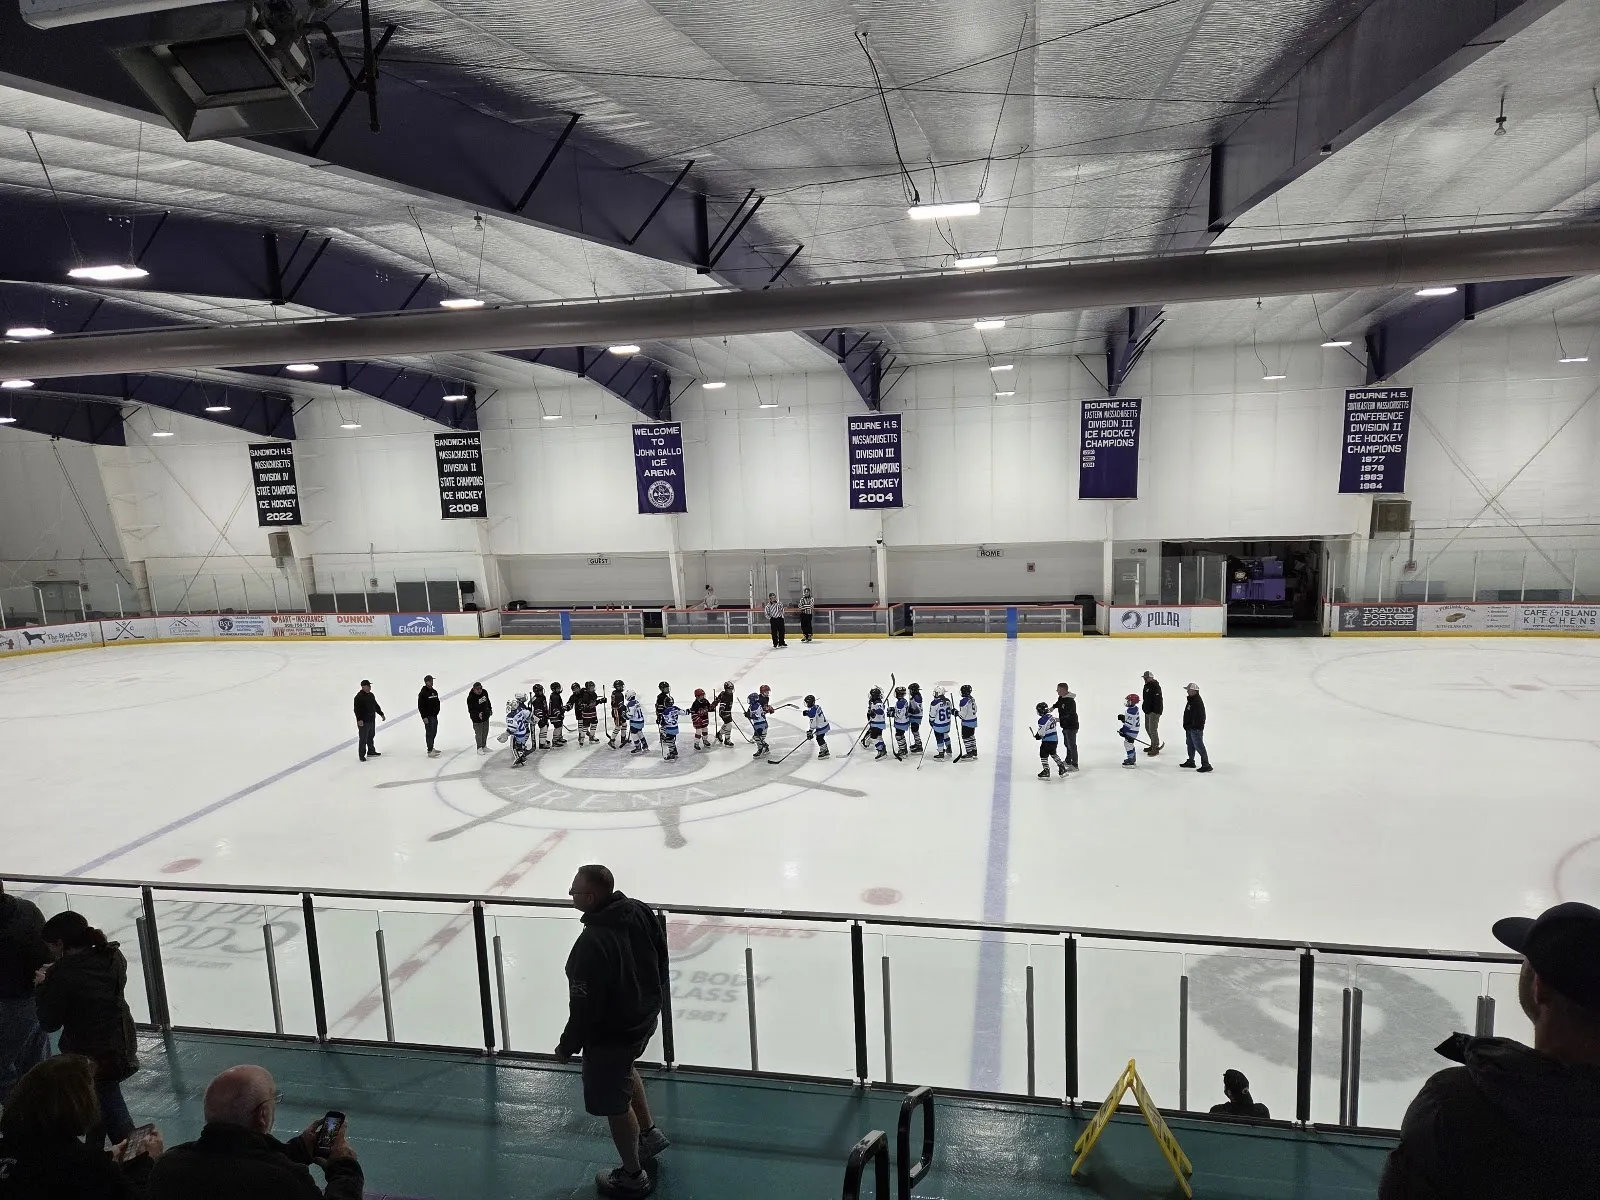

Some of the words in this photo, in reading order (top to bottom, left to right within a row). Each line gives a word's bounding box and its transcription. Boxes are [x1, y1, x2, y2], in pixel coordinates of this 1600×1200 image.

[1377, 401, 1409, 409] MASSACHUSETTS
[1104, 410, 1137, 418] MASSACHUSETTS
[1350, 412, 1404, 421] CONFERENCE
[851, 422, 881, 430] BOURNE
[1088, 420, 1118, 428] DIVISION
[1351, 423, 1389, 432] DIVISION
[635, 427, 679, 435] WELCOME
[852, 434, 897, 444] MASSACHUSETTS
[1365, 434, 1403, 442] HOCKEY
[1086, 439, 1134, 447] CHAMPIONS
[856, 449, 883, 458] DIVISION
[886, 448, 894, 457] III
[1348, 445, 1401, 453] CHAMPIONS
[439, 450, 478, 459] MASSACHUSETTS
[255, 460, 290, 469] MASSACHUSETTS
[444, 464, 468, 472] DIVISION
[471, 463, 476, 471] II
[852, 464, 868, 474] STATE
[870, 463, 899, 474] CHAMPIONS
[260, 473, 280, 481] DIVISION
[440, 477, 455, 487] STATE
[457, 476, 483, 486] CHAMPIONS
[853, 480, 865, 489] ICE
[868, 478, 899, 488] HOCKEY
[257, 486, 271, 495] STATE
[272, 485, 296, 495] CHAMPIONS
[456, 491, 482, 499] HOCKEY
[859, 493, 893, 502] 2004
[271, 499, 295, 508] HOCKEY
[449, 504, 478, 512] 2008
[1148, 612, 1180, 627] POLAR
[399, 625, 435, 634] Electrolit
[500, 782, 716, 808] ARENA
[672, 986, 739, 1003] LASS
